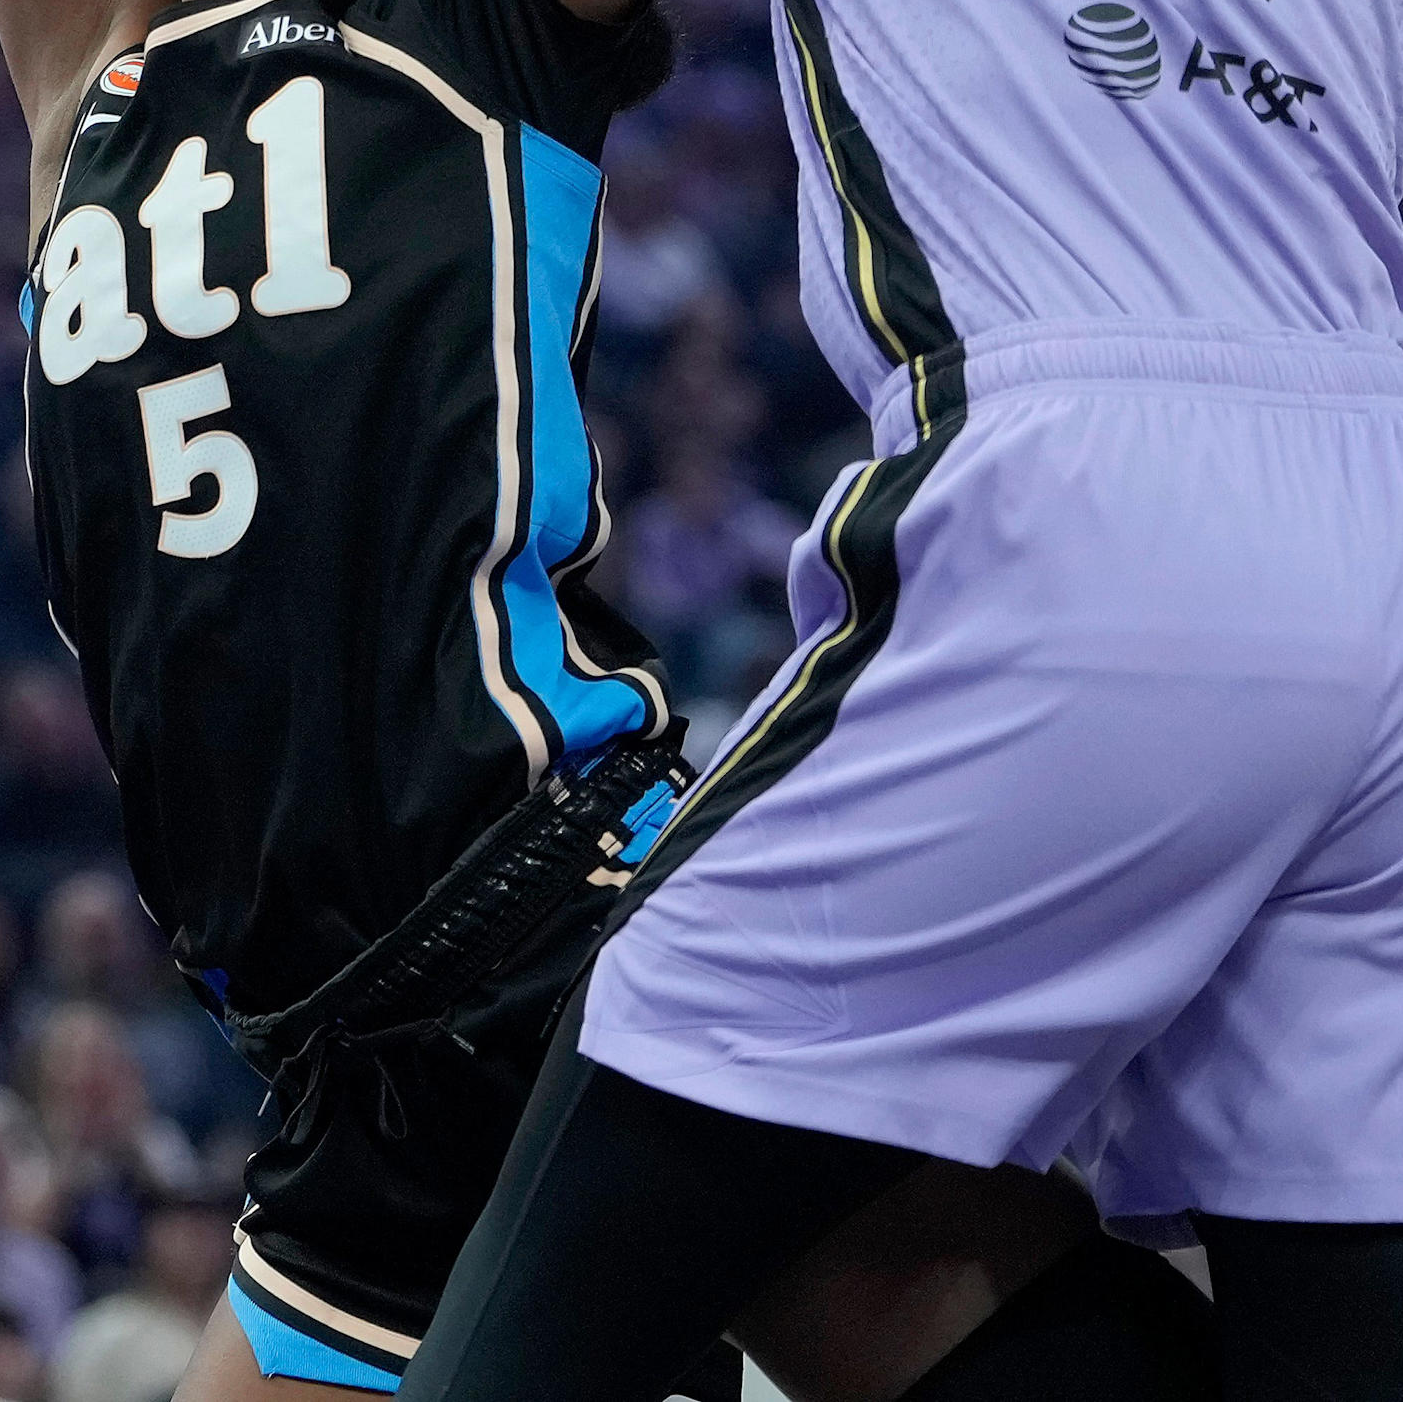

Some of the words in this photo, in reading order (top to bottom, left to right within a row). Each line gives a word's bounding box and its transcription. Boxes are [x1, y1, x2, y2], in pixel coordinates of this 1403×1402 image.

[240, 14, 342, 55] Alber
[1179, 36, 1326, 133] AT&T
[38, 75, 352, 386] atl
[137, 362, 259, 560] 5
